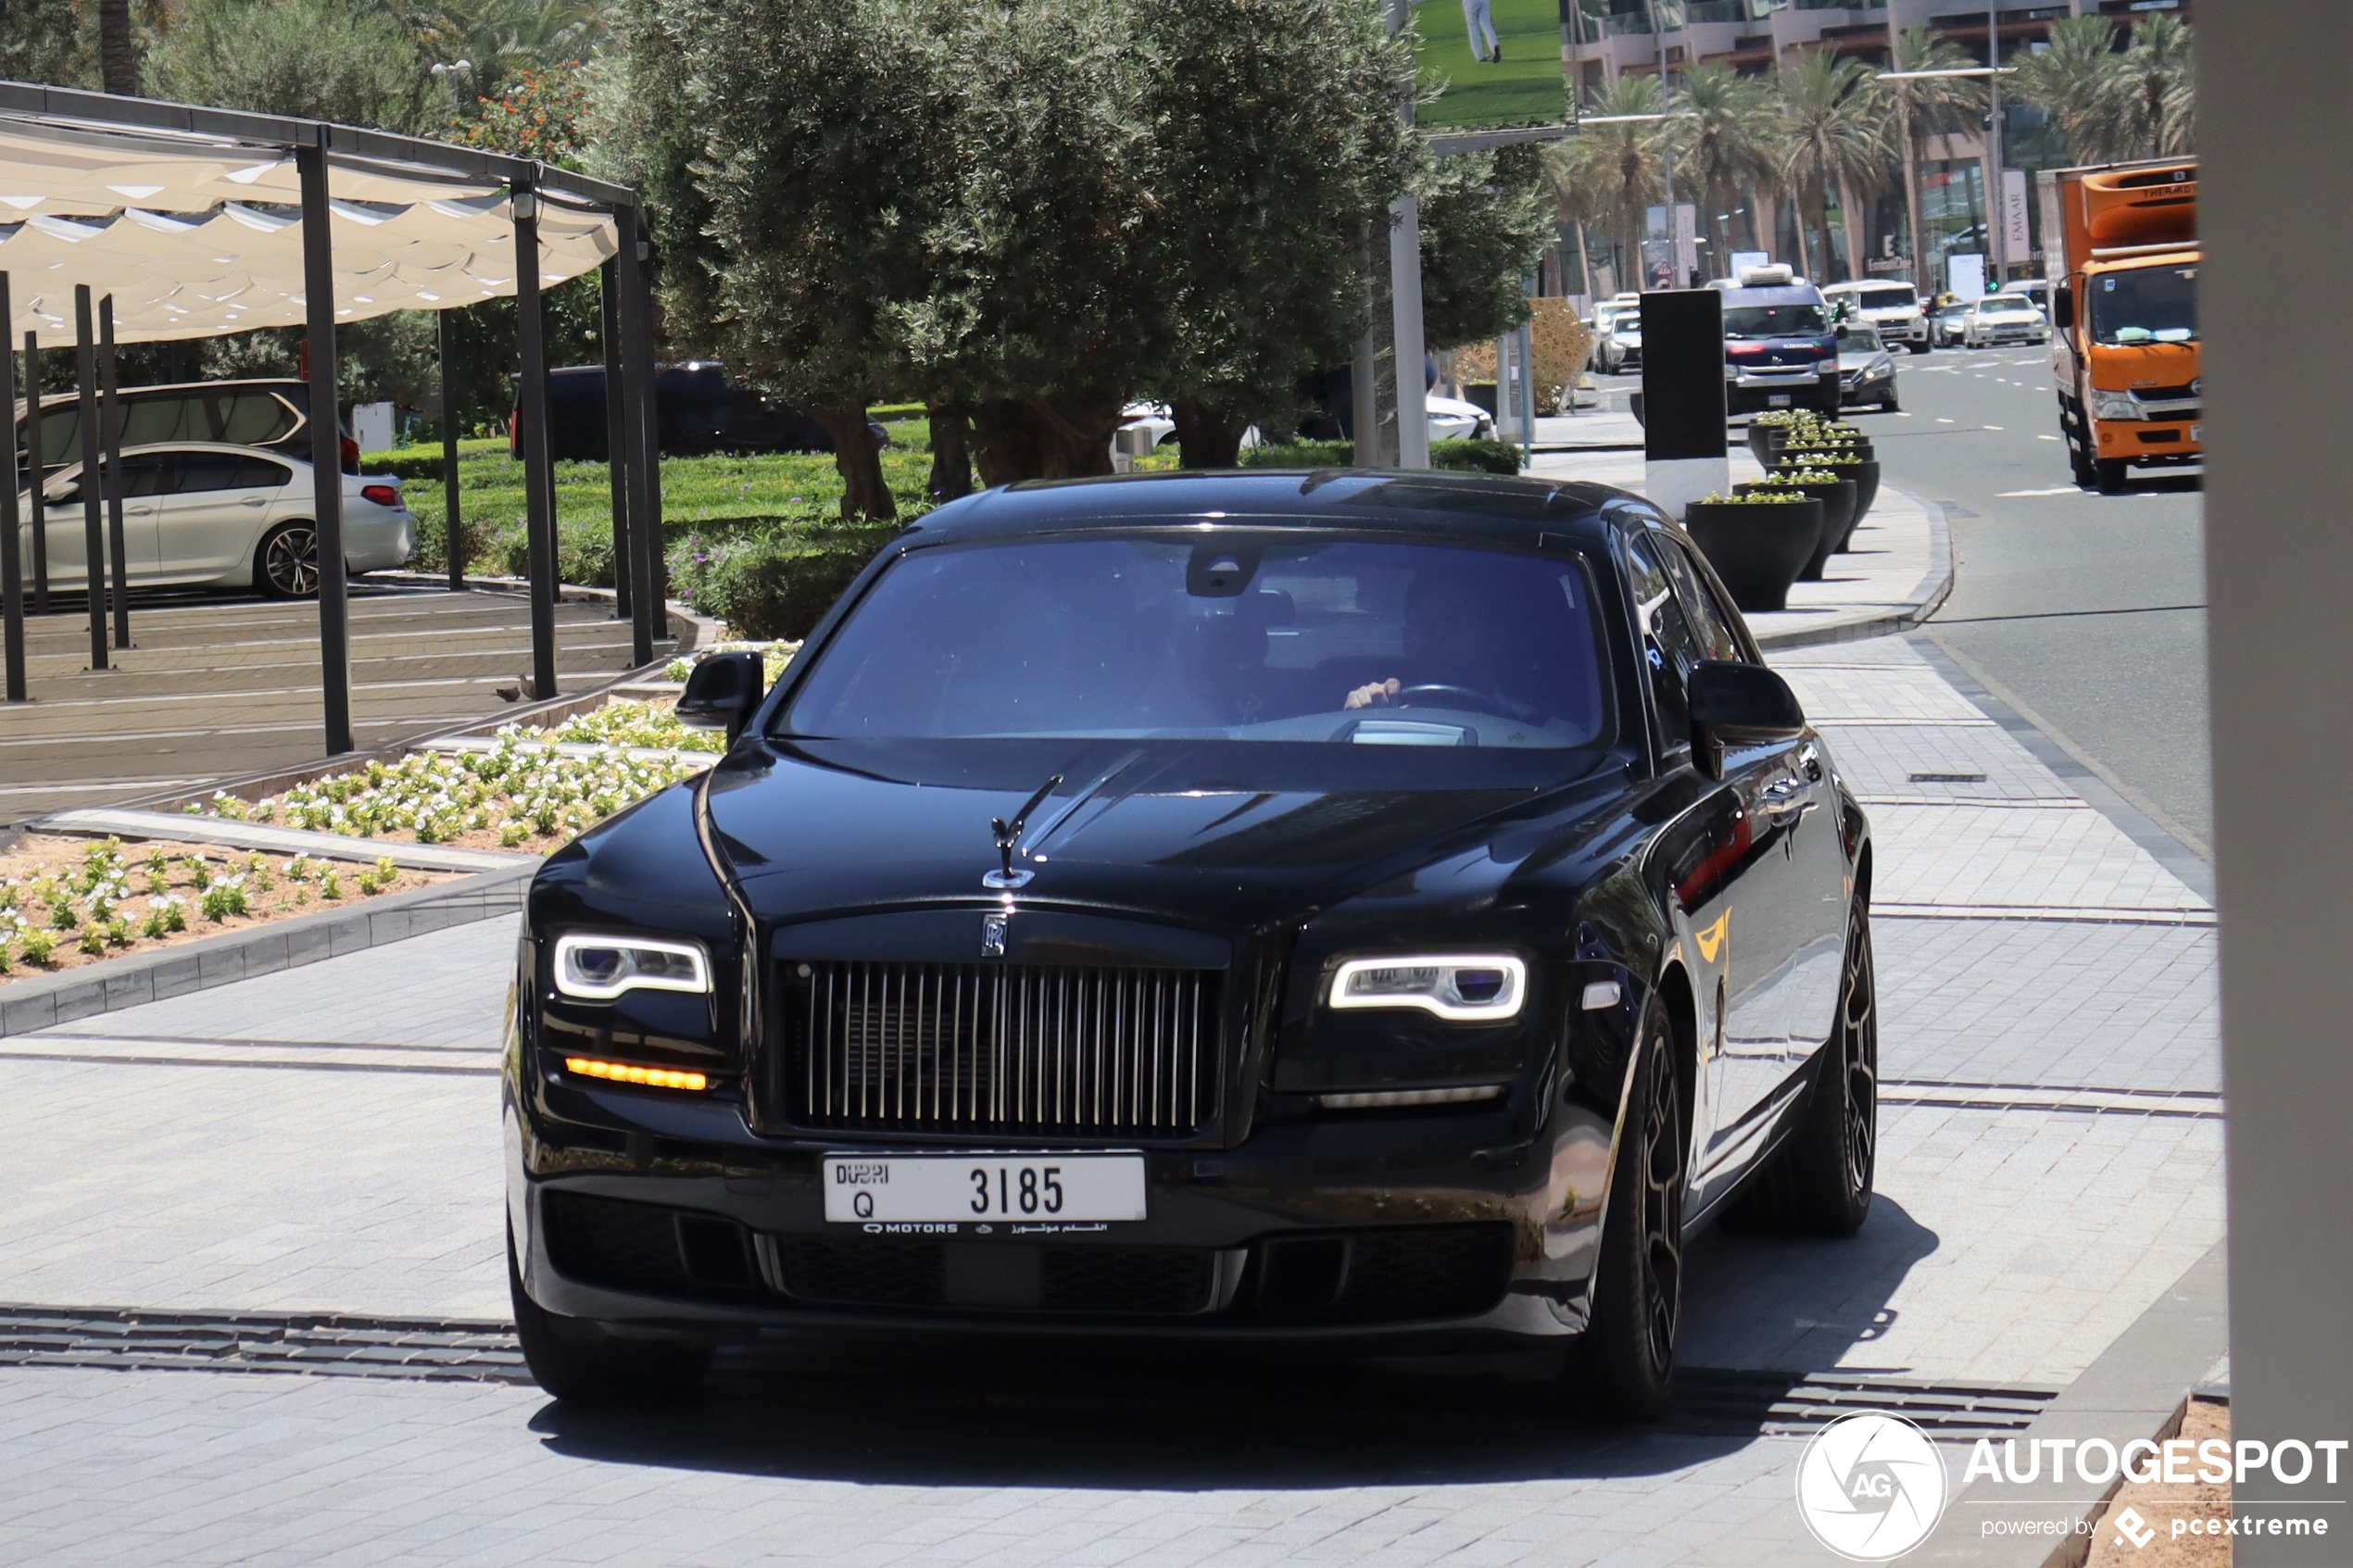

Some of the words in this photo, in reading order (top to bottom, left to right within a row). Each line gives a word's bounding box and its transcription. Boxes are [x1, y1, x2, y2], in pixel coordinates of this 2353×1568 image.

[2010, 193, 2023, 242] EMAAR
[1883, 234, 1895, 257] E
[836, 1165, 888, 1184] DUBAI
[970, 1167, 1063, 1214] 3185
[854, 1191, 874, 1219] Q
[886, 1223, 958, 1233] MOTORS
